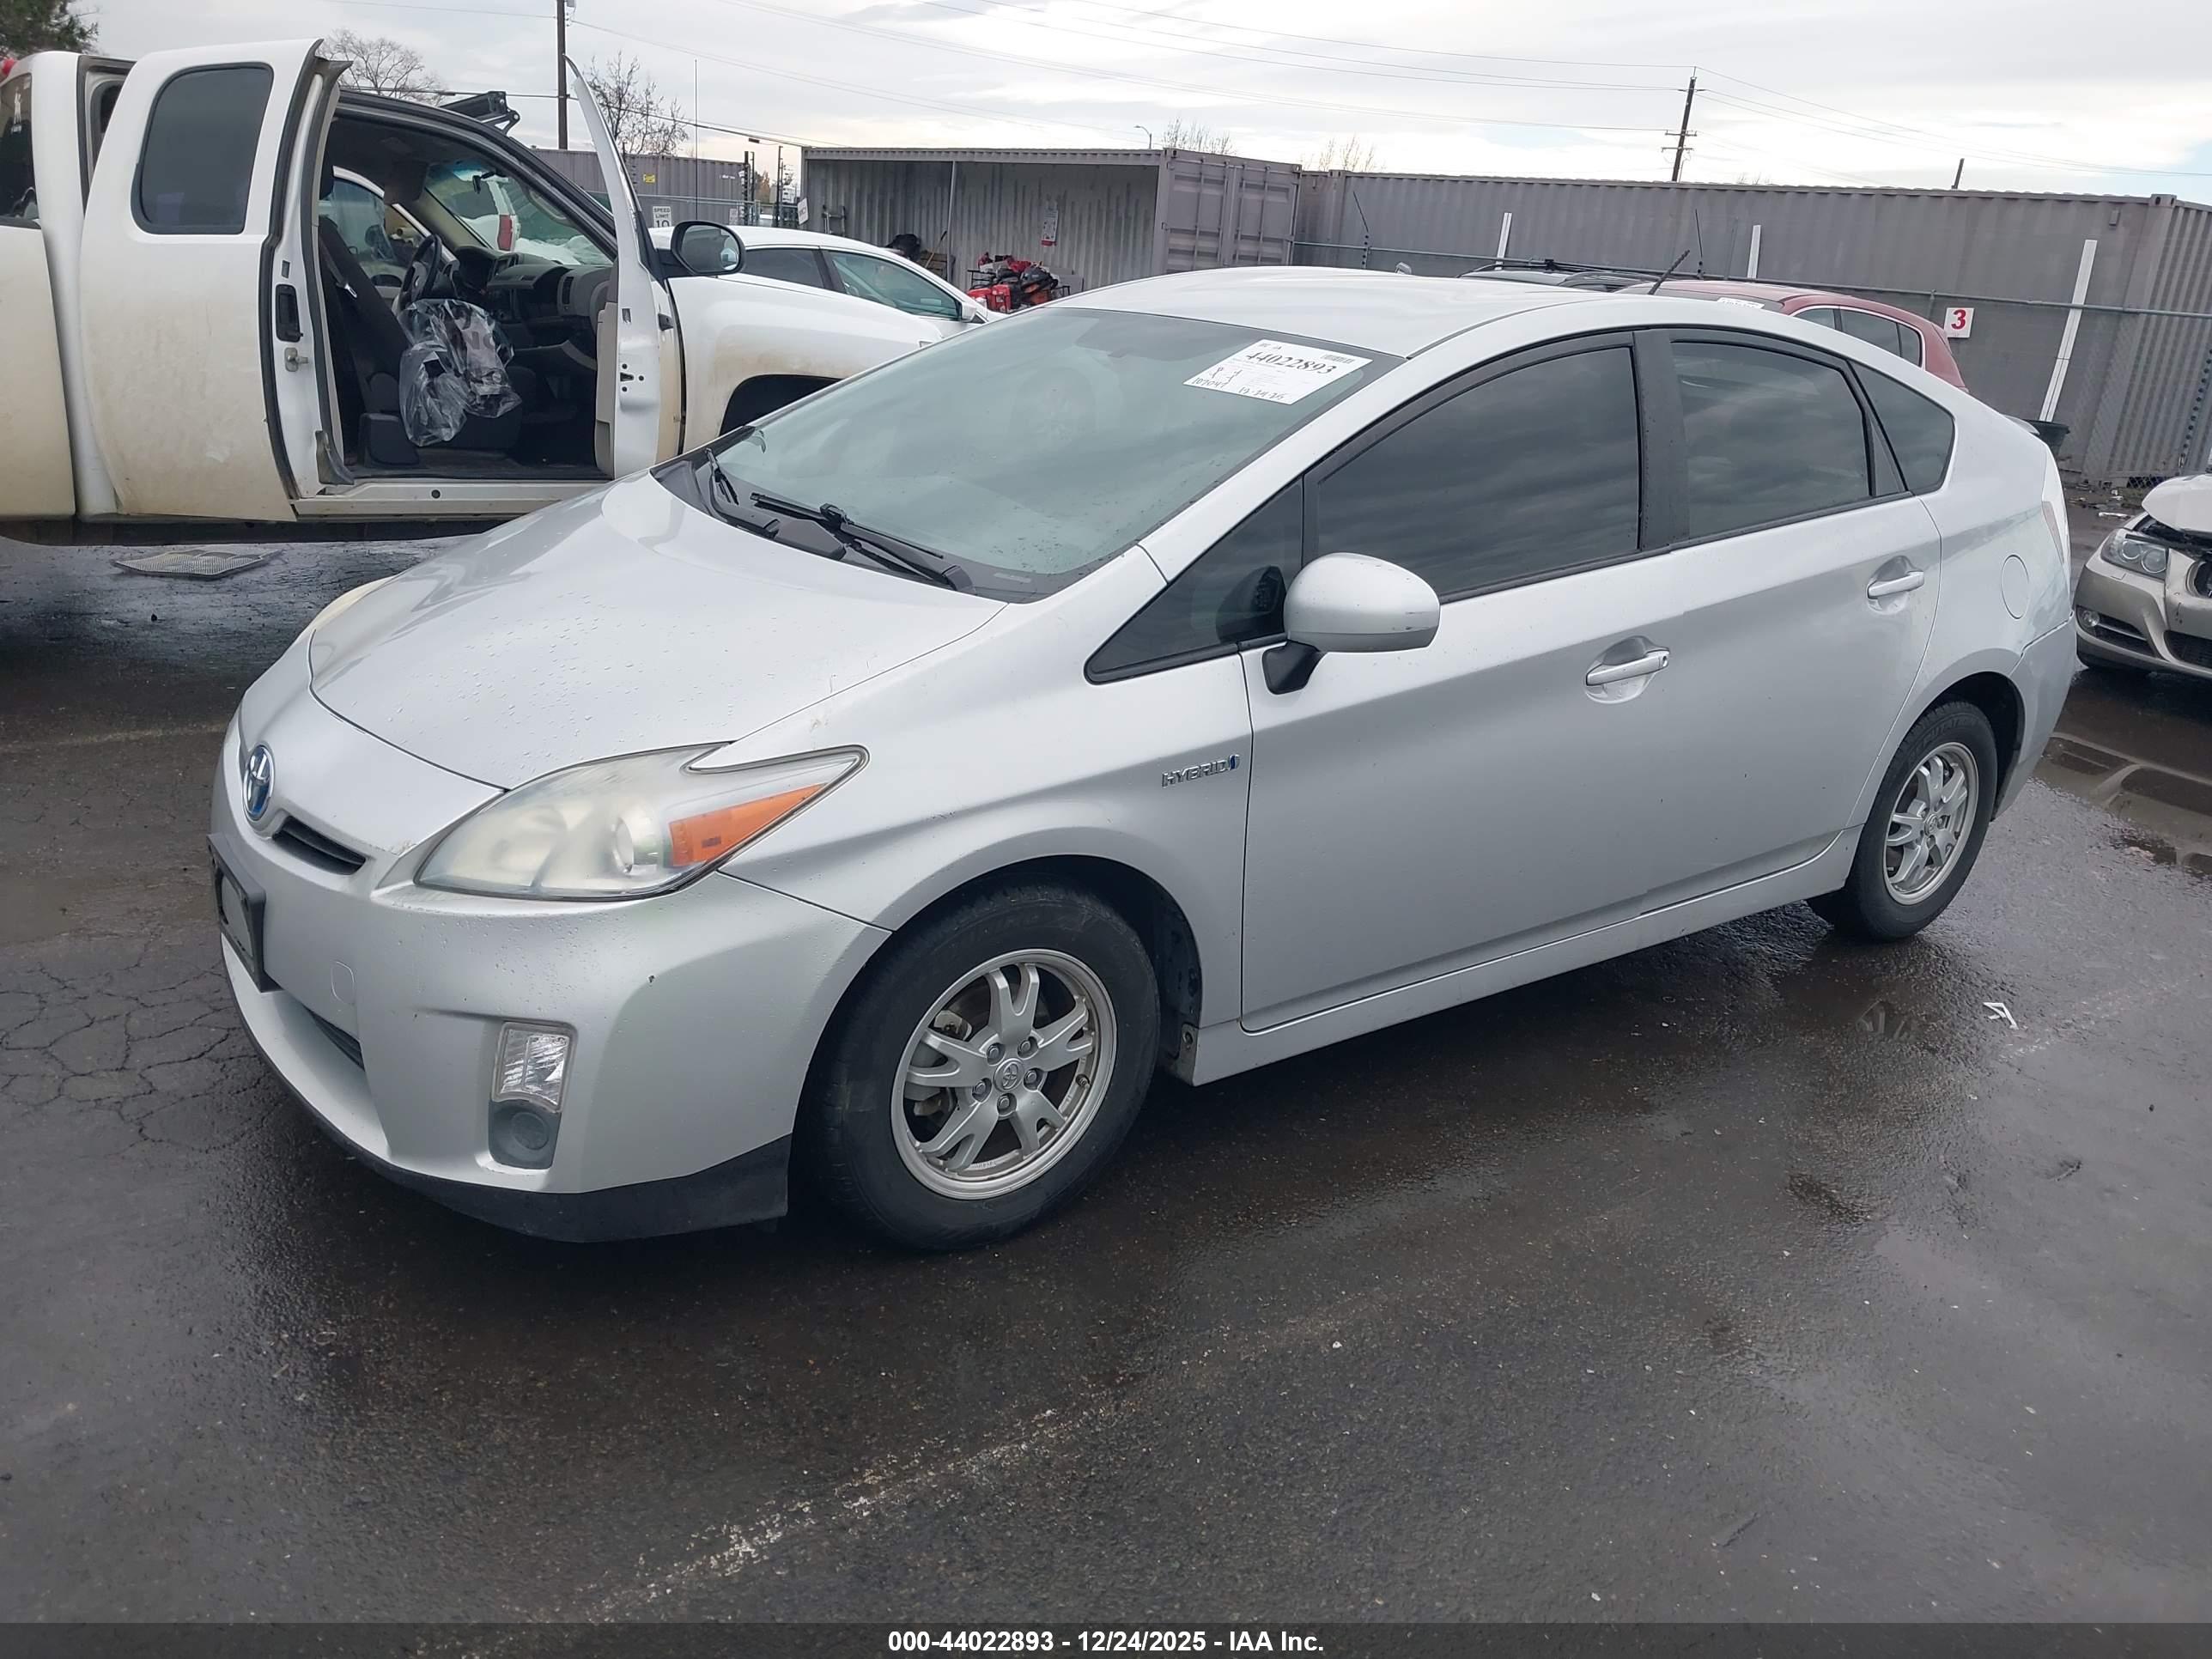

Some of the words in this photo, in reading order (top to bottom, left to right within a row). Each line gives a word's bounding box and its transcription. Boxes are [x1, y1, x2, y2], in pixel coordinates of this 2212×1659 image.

[1950, 309, 1966, 330] 3
[1246, 351, 1337, 374] 44022893
[1161, 759, 1229, 788] HYBRID
